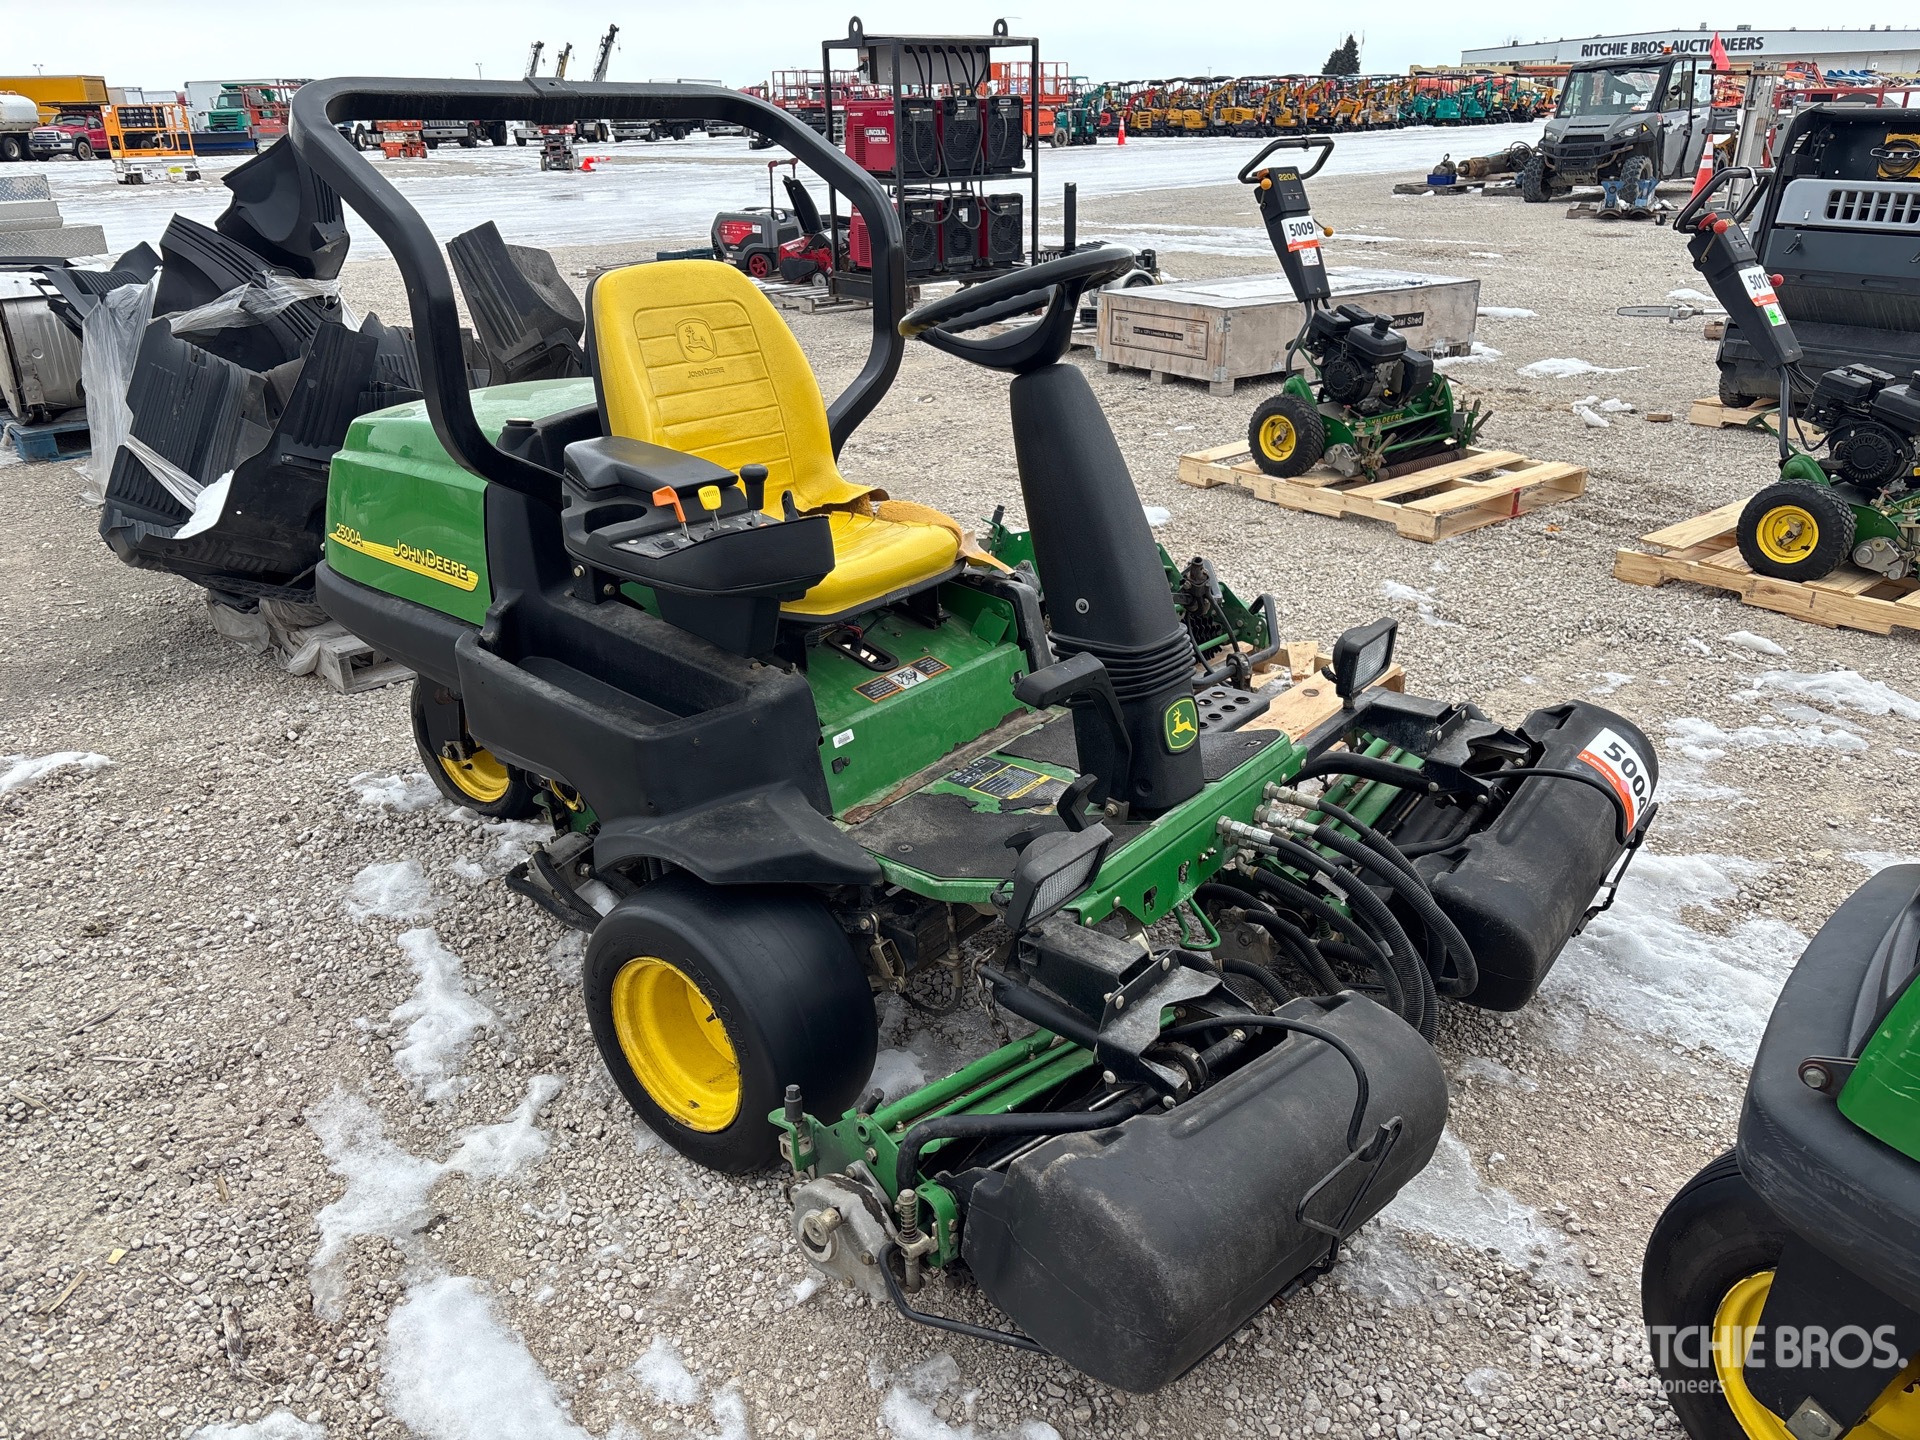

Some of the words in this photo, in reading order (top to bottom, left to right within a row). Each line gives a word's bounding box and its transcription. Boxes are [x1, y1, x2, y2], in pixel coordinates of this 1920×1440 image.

[1580, 42, 1628, 57] RITCHIE
[1670, 36, 1765, 54] AUCTINEERS
[1278, 173, 1298, 182] 220A
[1288, 221, 1315, 237] 5009
[1407, 315, 1423, 325] Shed
[1382, 412, 1404, 424] DEERE
[335, 521, 364, 548] 2500A
[392, 538, 428, 567] JOHN
[425, 547, 469, 582] DEERE
